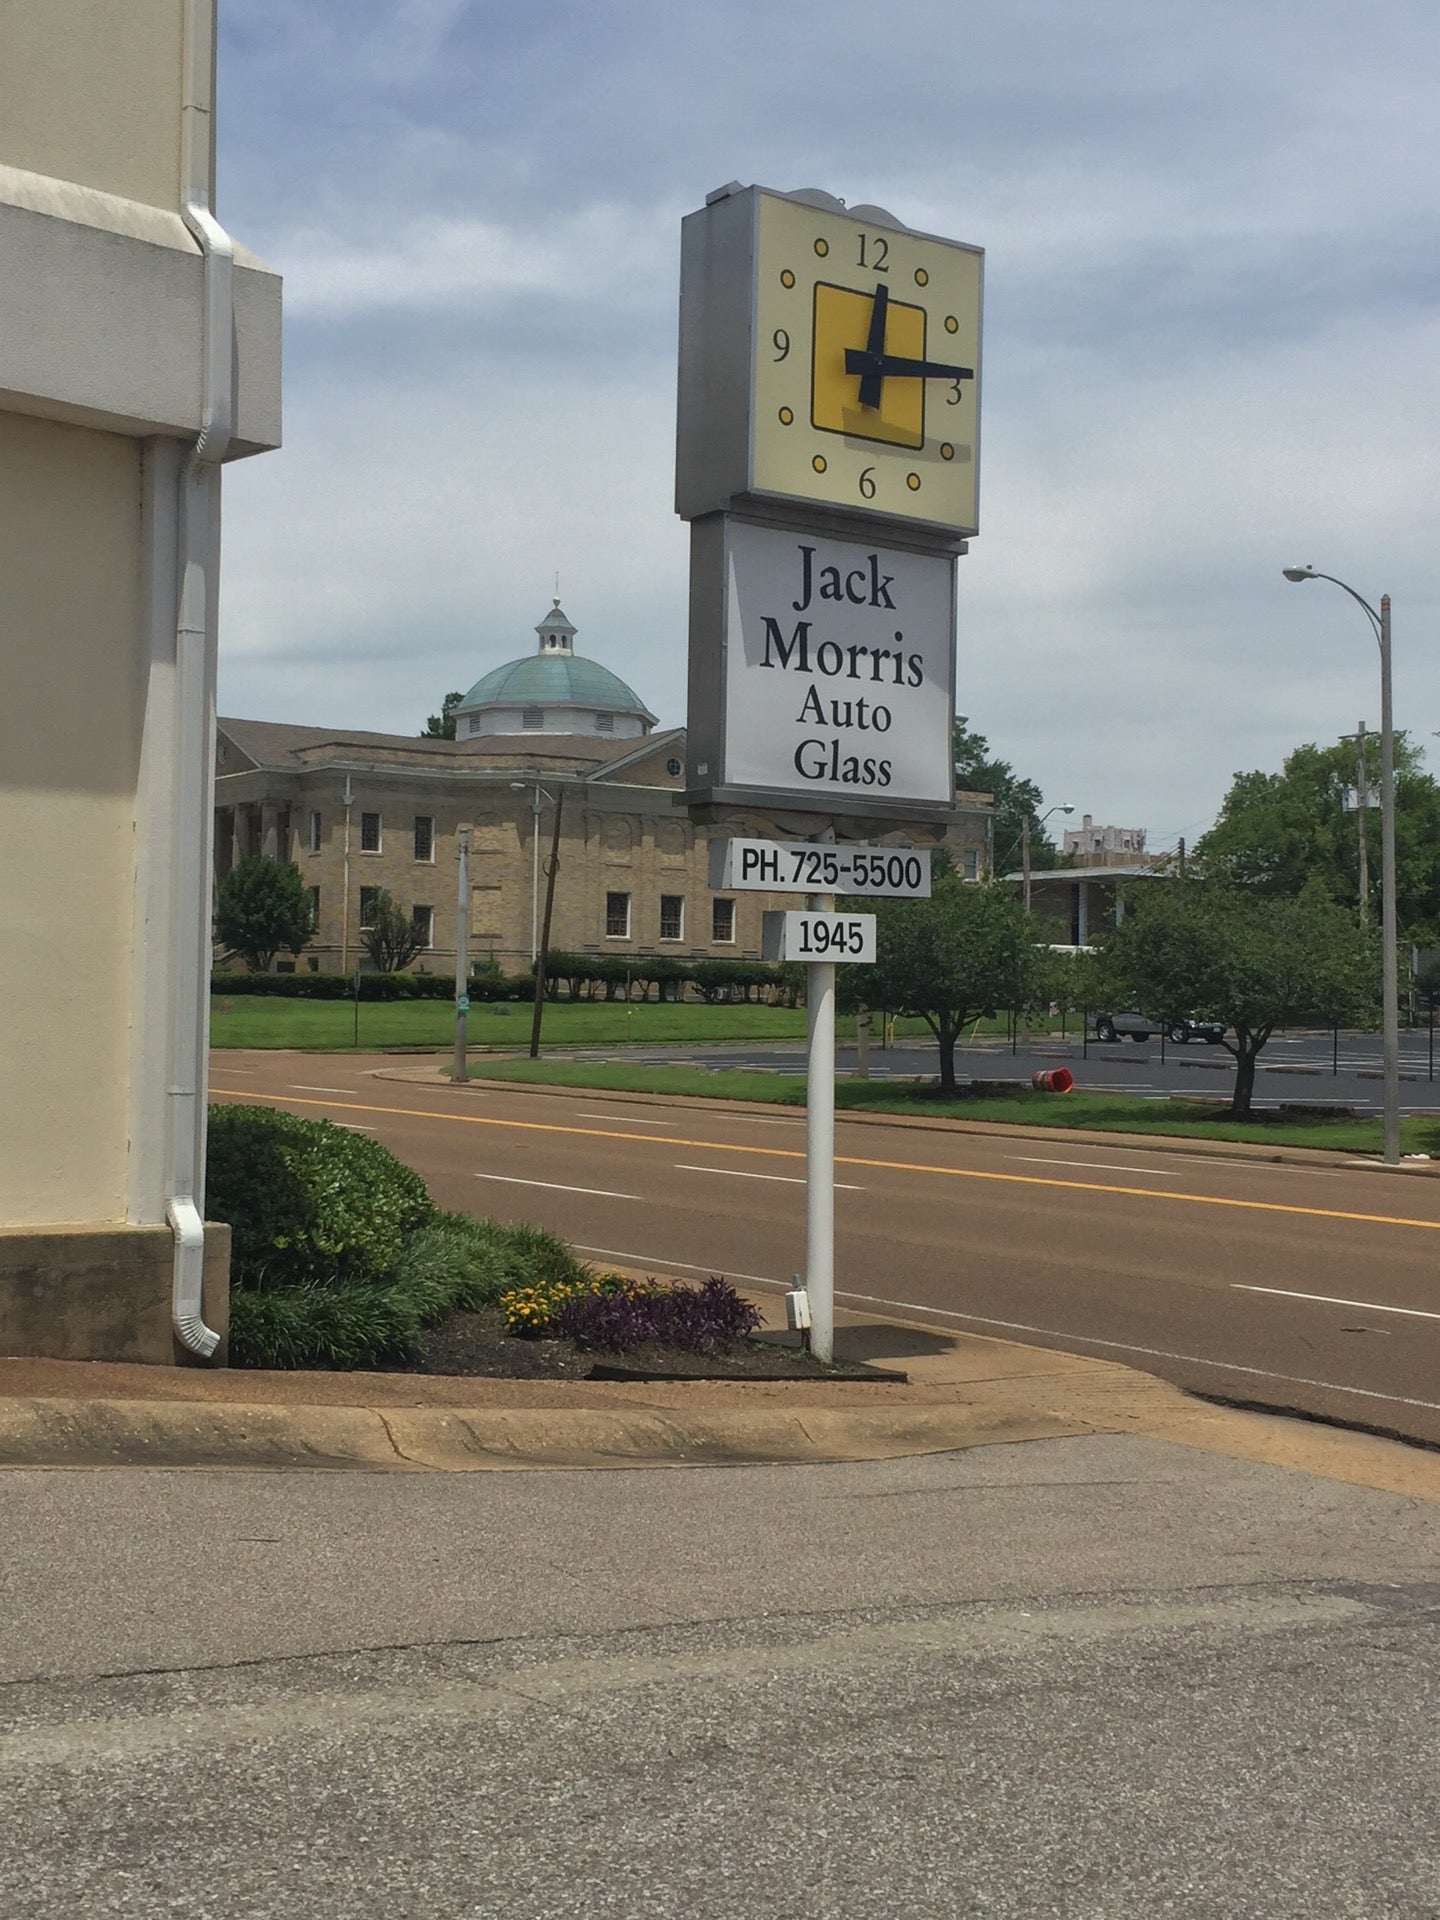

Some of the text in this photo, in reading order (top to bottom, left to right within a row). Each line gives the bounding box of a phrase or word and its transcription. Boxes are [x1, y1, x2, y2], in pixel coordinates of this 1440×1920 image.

[856, 233, 889, 273] 12
[773, 329, 790, 362] 9
[945, 377, 962, 405] 3
[859, 467, 876, 499] 6
[792, 544, 896, 612] Jack
[759, 616, 924, 688] Morris
[796, 683, 892, 732] Auto
[794, 738, 892, 787] Glass
[799, 920, 864, 954] 1945
